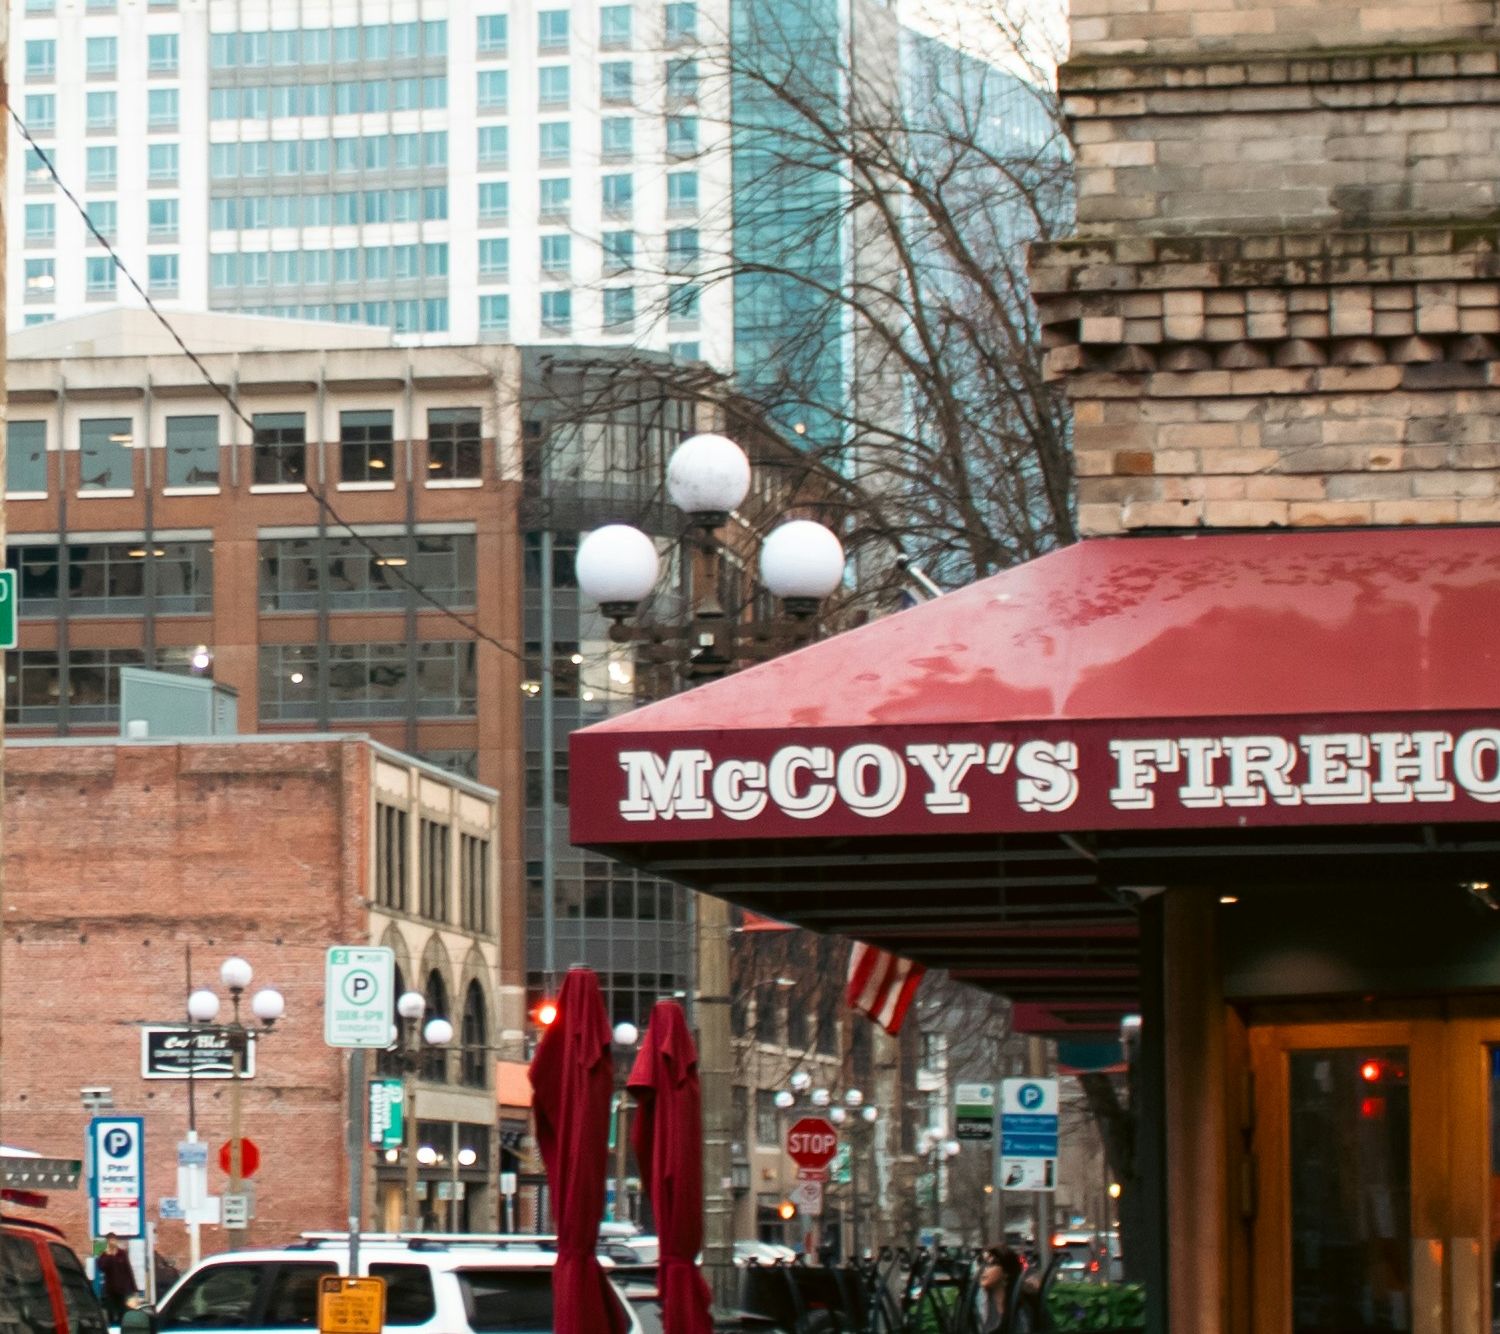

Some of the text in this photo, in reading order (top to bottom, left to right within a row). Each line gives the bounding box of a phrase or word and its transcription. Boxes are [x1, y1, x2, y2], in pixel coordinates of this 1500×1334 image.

[618, 740, 1080, 821] McCOY'S
[334, 951, 345, 963] 2
[353, 977, 369, 998] P
[788, 1132, 837, 1155] STOP
